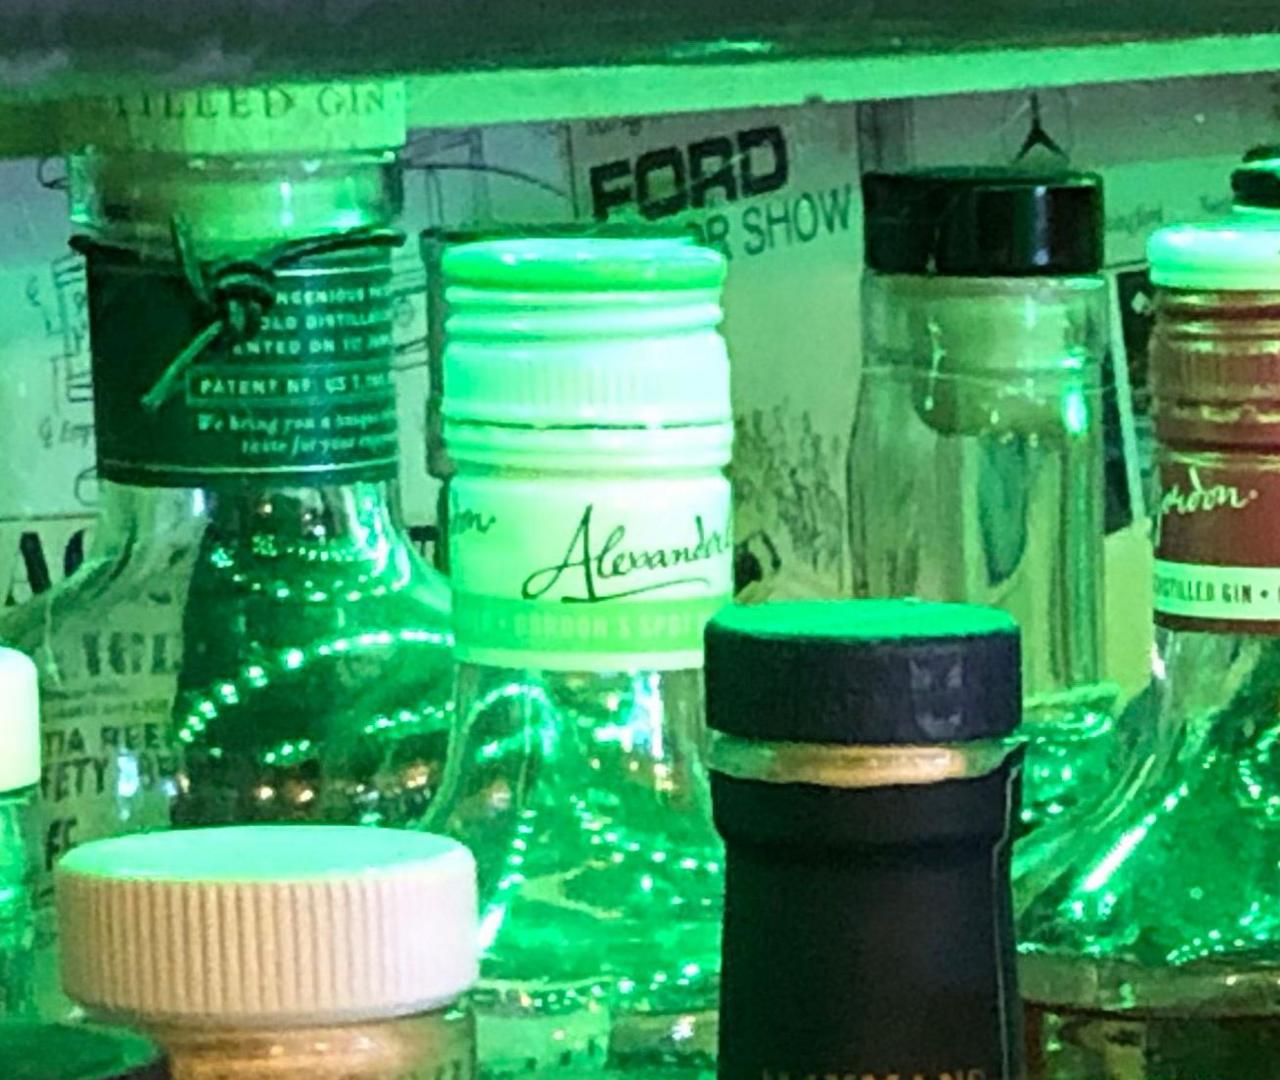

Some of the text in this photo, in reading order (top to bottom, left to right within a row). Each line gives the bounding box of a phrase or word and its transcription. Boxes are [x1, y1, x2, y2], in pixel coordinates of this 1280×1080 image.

[316, 83, 385, 116] GIN
[590, 126, 788, 222] FORD
[741, 183, 851, 257] SHOW
[200, 378, 278, 396] PATENT
[228, 415, 280, 437] bring
[1221, 582, 1252, 605] GIN
